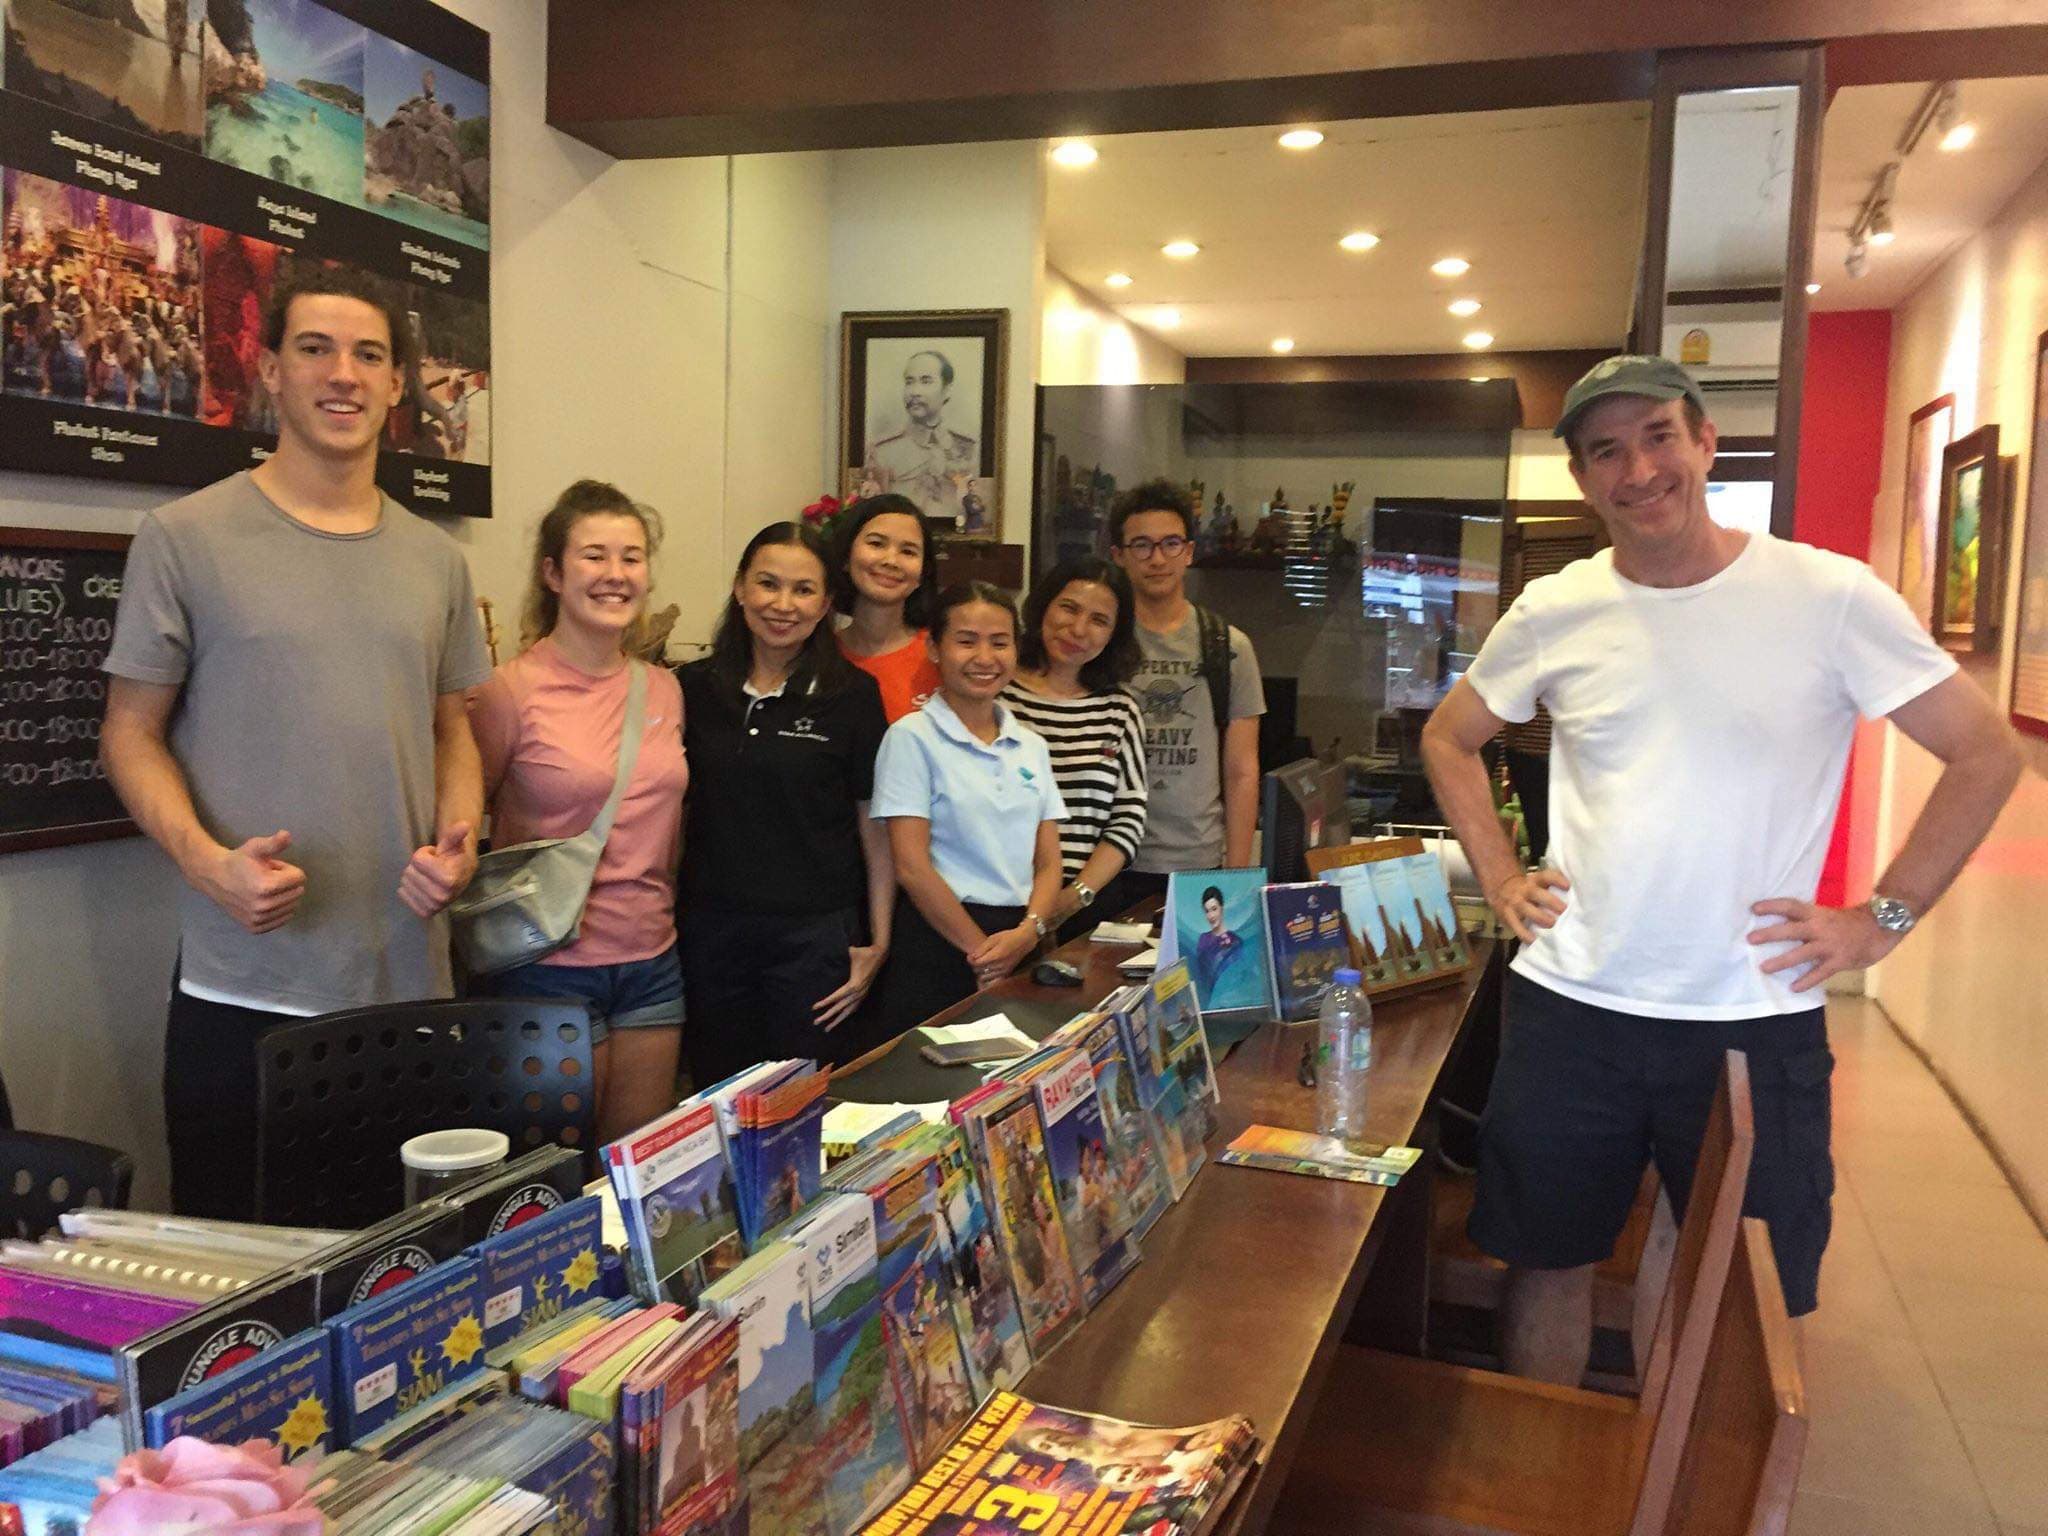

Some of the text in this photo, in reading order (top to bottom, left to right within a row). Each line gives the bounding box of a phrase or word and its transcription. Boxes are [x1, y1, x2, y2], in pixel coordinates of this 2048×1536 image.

[1135, 660, 1192, 676] PERTY
[491, 1189, 533, 1237] UNGLE
[353, 1253, 401, 1304] UNGLE
[183, 1328, 241, 1390] UNGLE
[919, 1456, 962, 1489] BEST
[960, 1421, 995, 1446] THE
[979, 1391, 1022, 1425] YEAR
[973, 1483, 1061, 1531] 3
